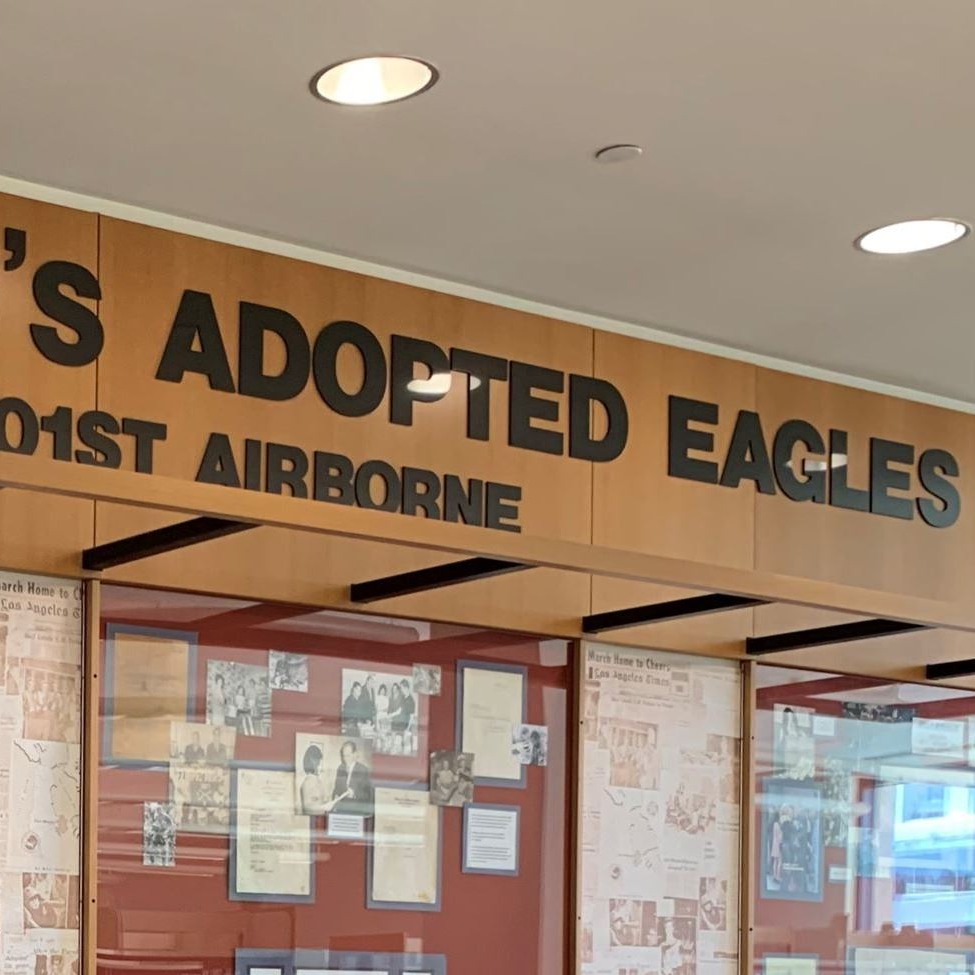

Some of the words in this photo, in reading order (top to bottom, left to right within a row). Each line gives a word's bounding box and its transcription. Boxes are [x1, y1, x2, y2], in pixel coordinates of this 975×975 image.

[155, 288, 629, 463] ADOPTED
[667, 394, 961, 528] EAGLES
[195, 432, 522, 534] AIRBORNE
[27, 581, 55, 597] Home
[59, 588, 69, 599] to
